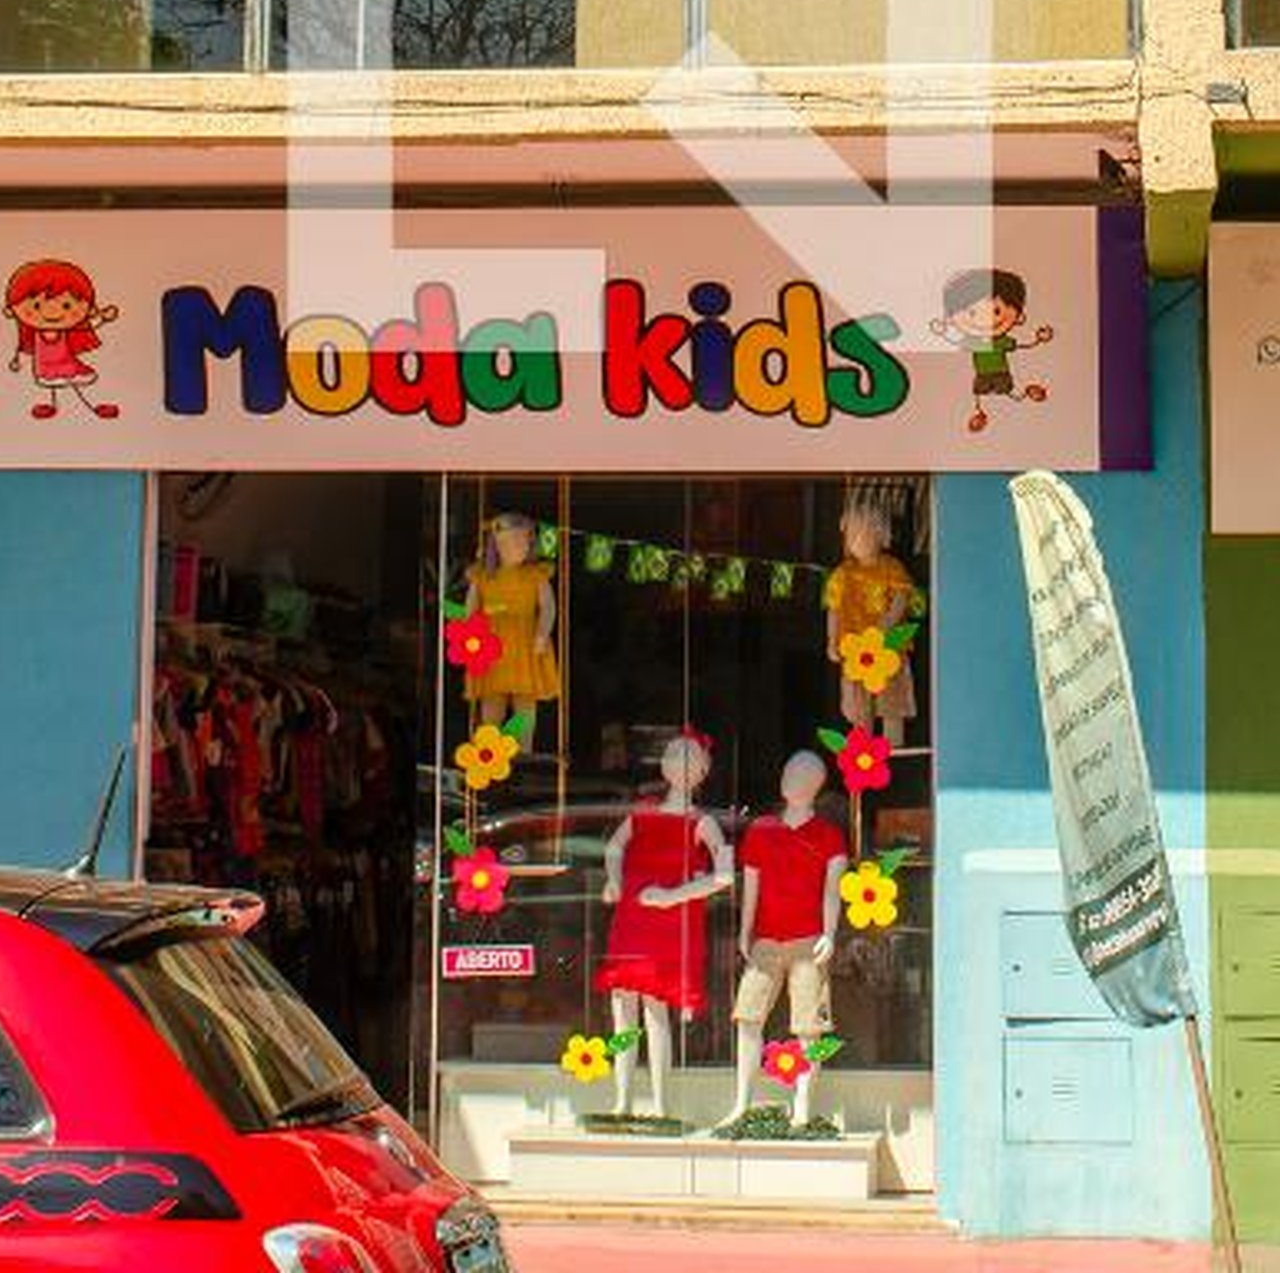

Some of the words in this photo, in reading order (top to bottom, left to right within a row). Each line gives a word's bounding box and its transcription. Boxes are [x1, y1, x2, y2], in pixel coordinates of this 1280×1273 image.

[160, 281, 562, 428] Moda
[602, 278, 910, 428] kids
[456, 949, 524, 969] ABERTO
